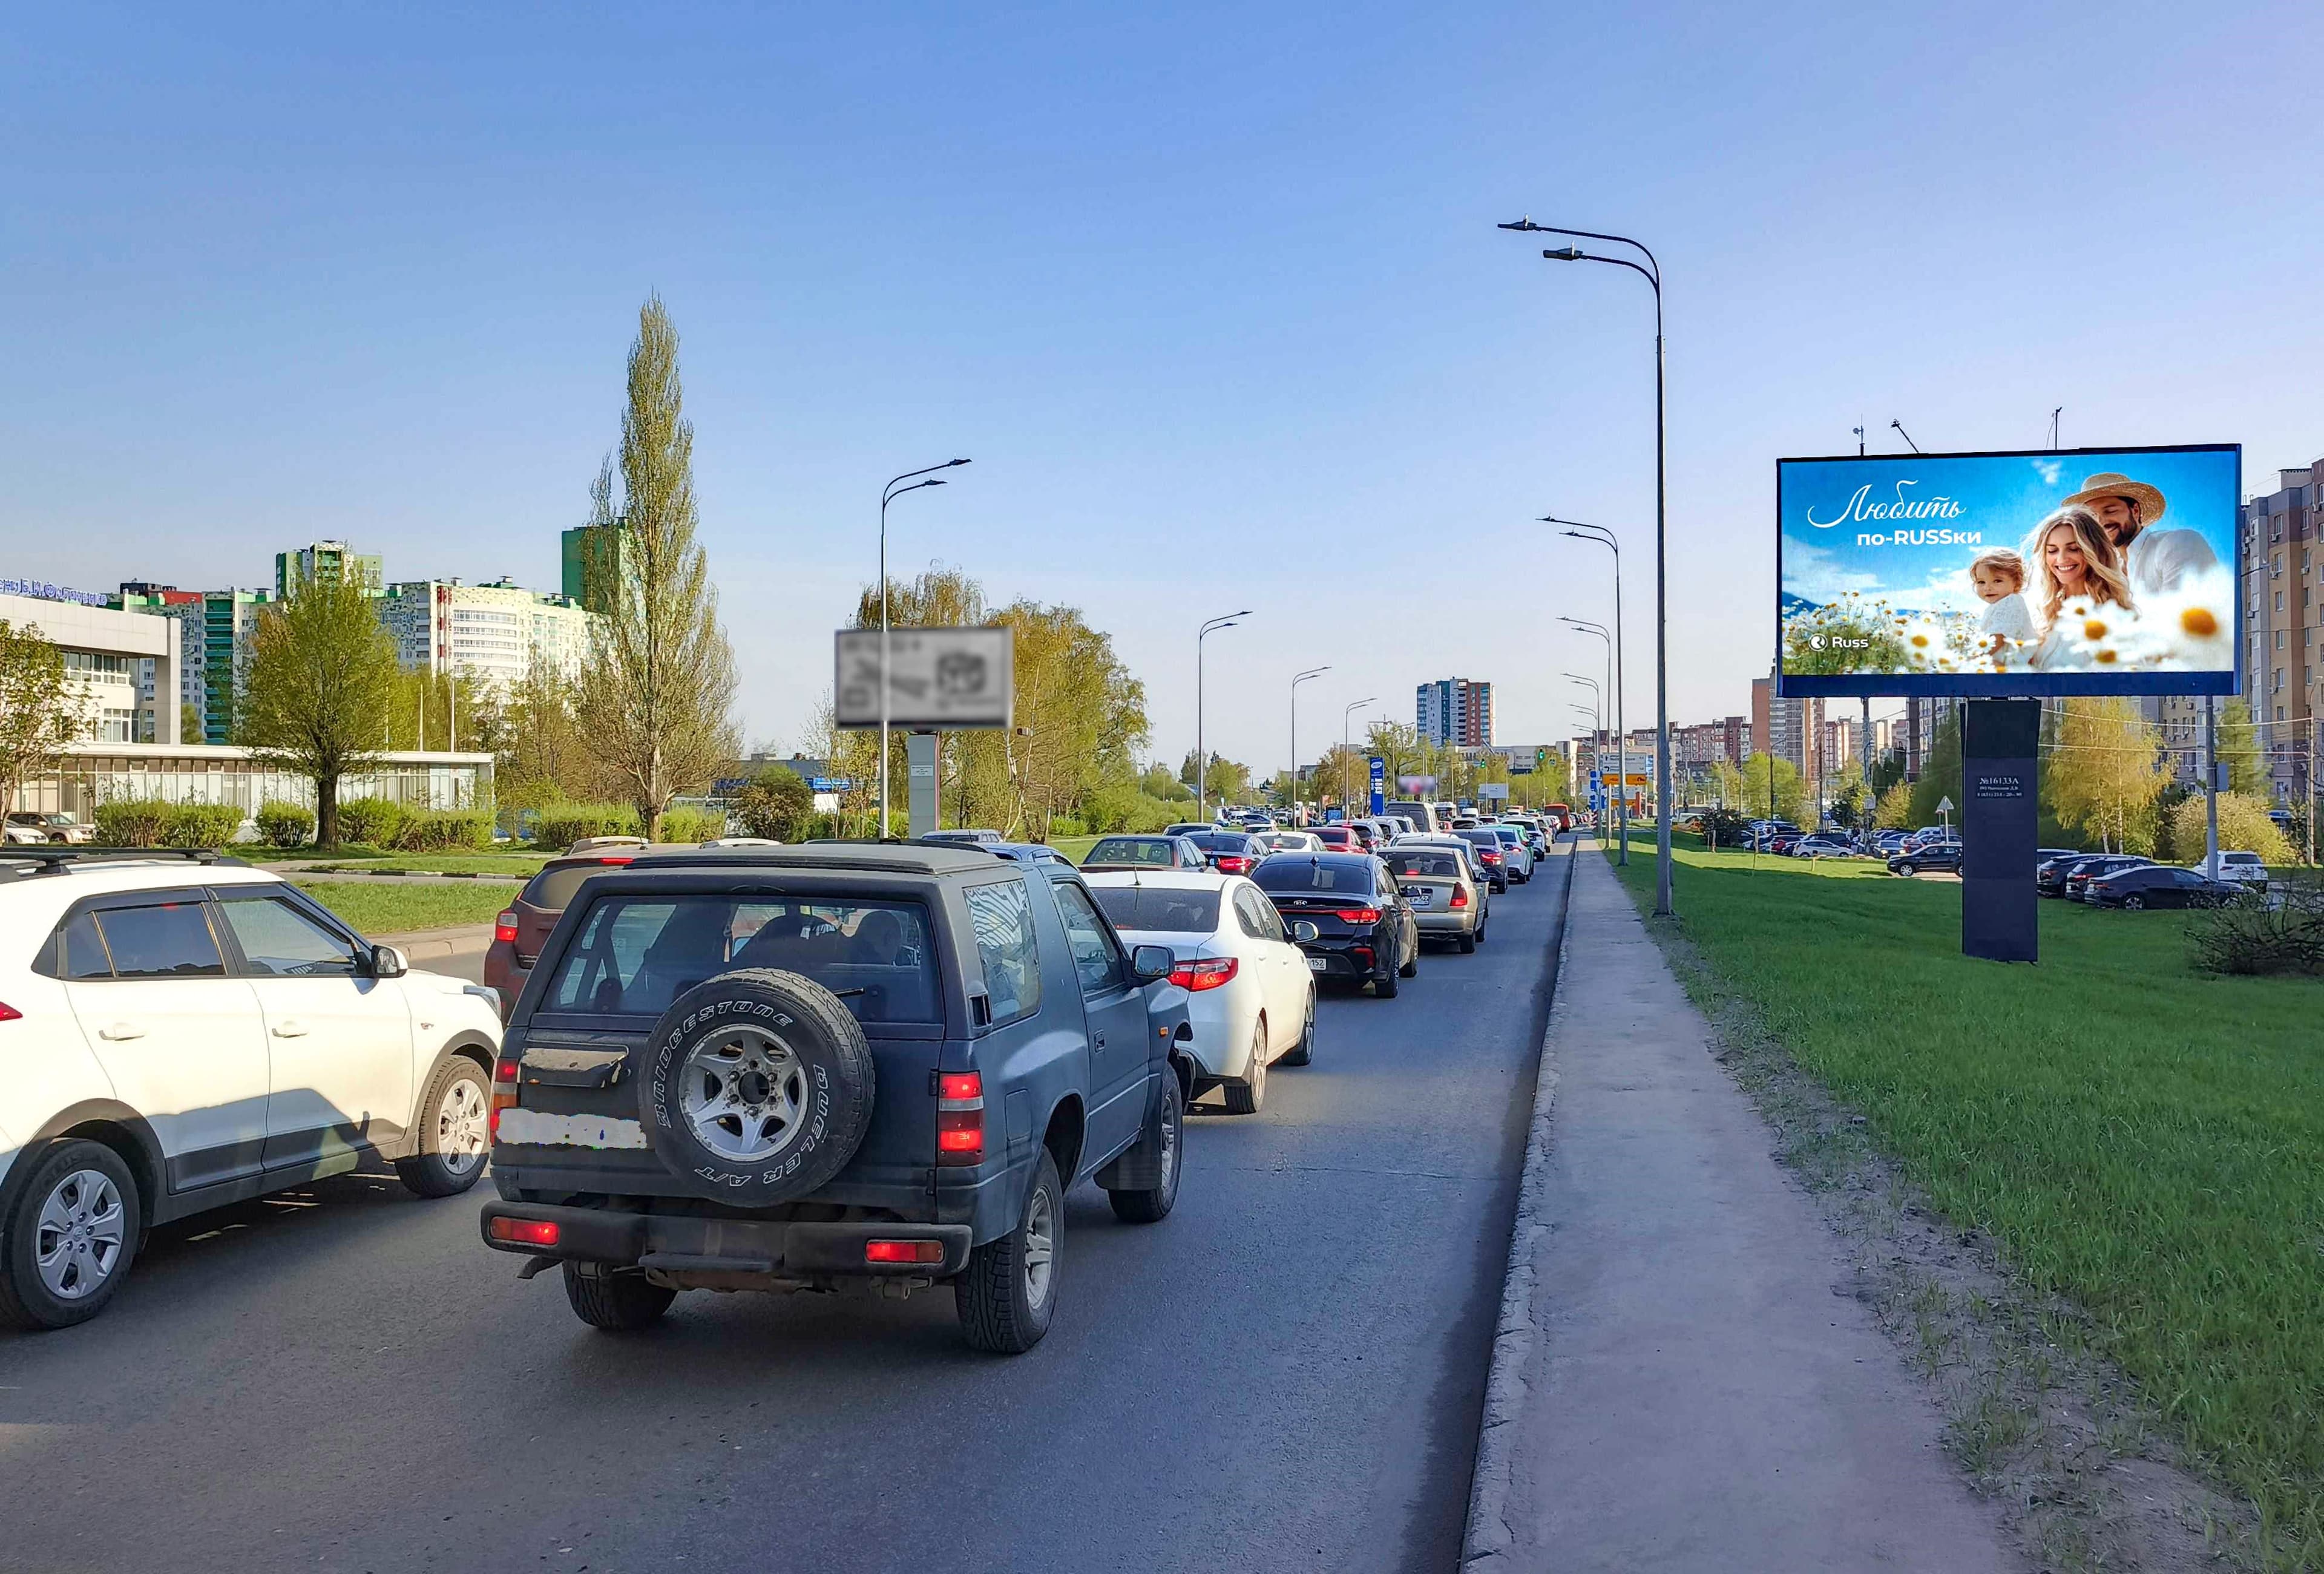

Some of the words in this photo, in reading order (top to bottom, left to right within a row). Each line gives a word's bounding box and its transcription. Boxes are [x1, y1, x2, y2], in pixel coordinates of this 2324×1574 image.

[1808, 480, 1966, 528] Любить
[1857, 529, 1981, 546] по-RUSSки
[1832, 637, 1869, 649] Russ
[654, 1000, 793, 1129] BRIDGESTONE
[763, 1064, 829, 1184] DUELER
[694, 1166, 752, 1187] A/T
